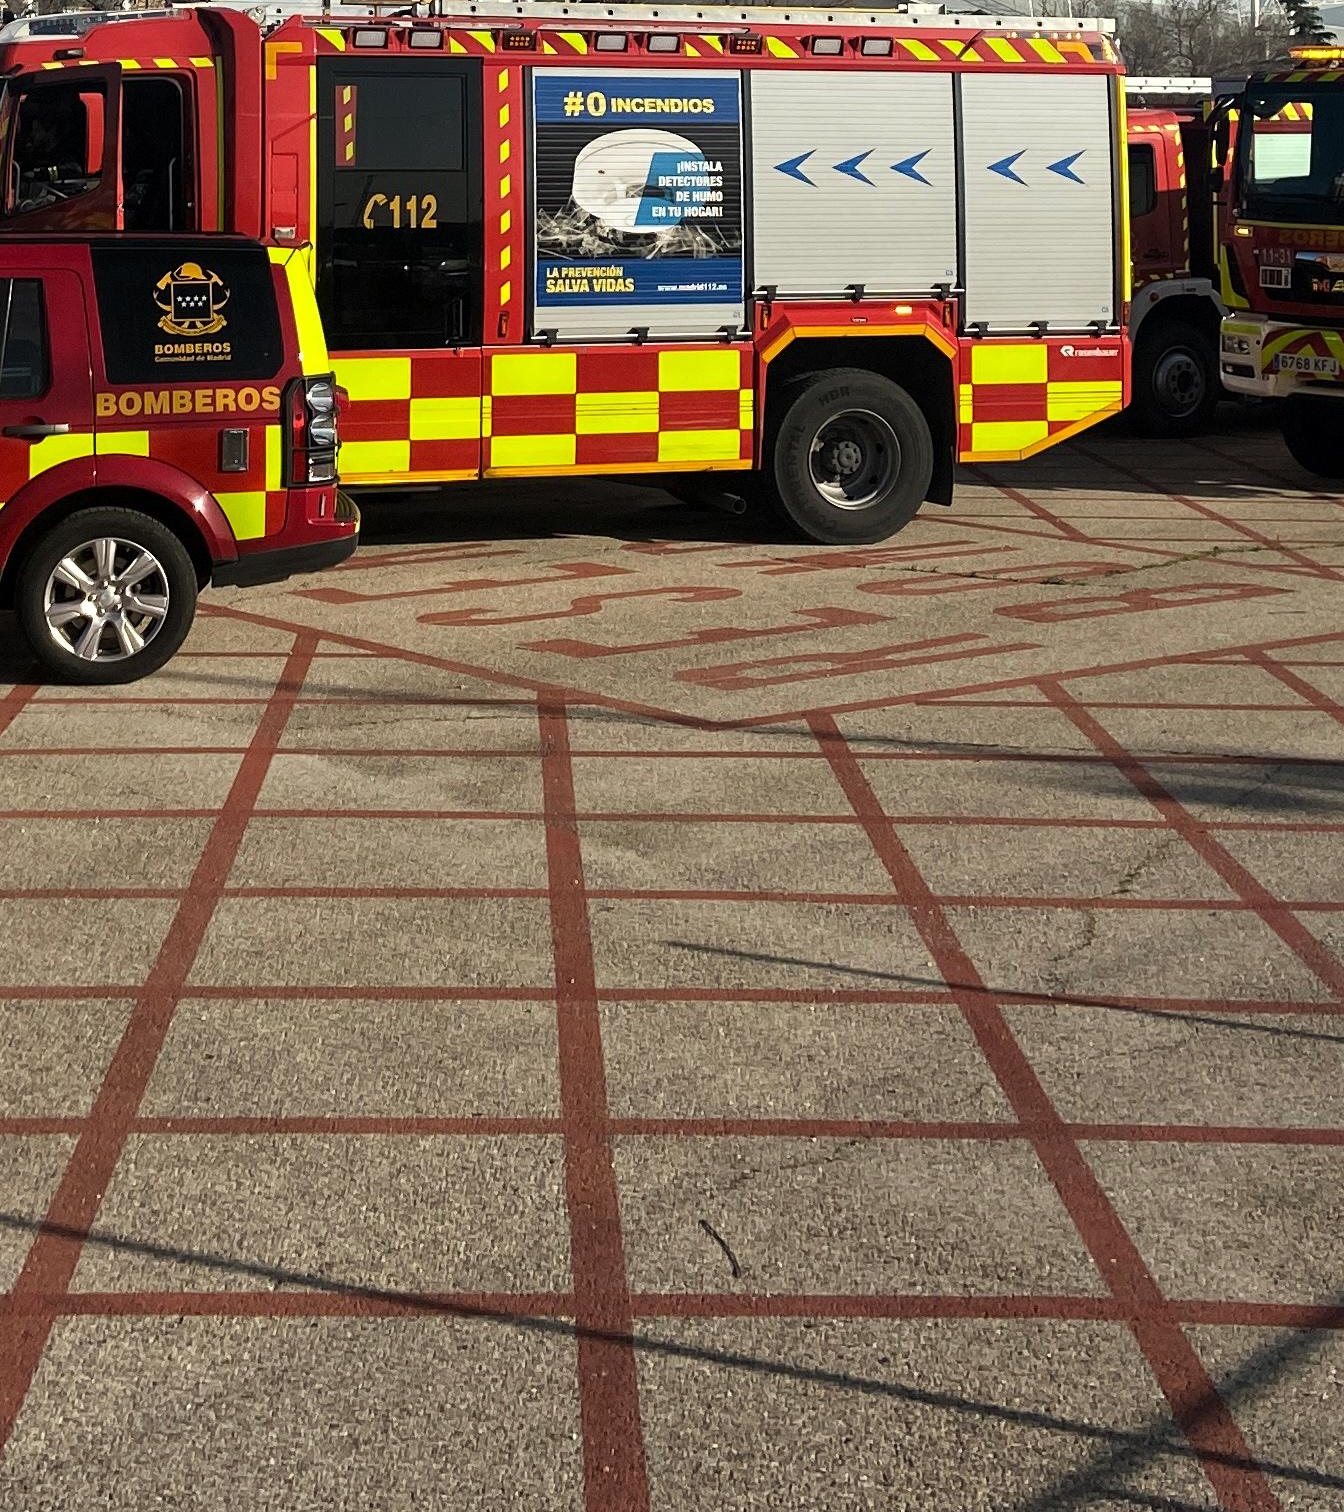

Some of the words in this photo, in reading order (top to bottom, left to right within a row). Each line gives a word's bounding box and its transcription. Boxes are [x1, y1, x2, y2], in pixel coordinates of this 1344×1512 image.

[563, 91, 607, 117] #0
[611, 97, 715, 114] INCENDIOS
[676, 160, 723, 173] ¡INSTALA
[657, 175, 723, 188] DETECTORES
[675, 191, 690, 202] DE
[692, 191, 723, 202] HUMO
[389, 194, 438, 229] 112
[651, 206, 665, 217] EN
[667, 206, 682, 217] TU
[684, 205, 723, 217] HOGAR!
[546, 267, 559, 277] LA
[561, 264, 623, 277] PREVENCIÓN
[545, 279, 590, 293] SALVA
[592, 278, 635, 292] VIDAS
[154, 343, 231, 355] BOMBEROS
[1281, 356, 1311, 371] 6768
[1314, 359, 1338, 373] KFJ
[96, 385, 281, 417] BOMBEROS
